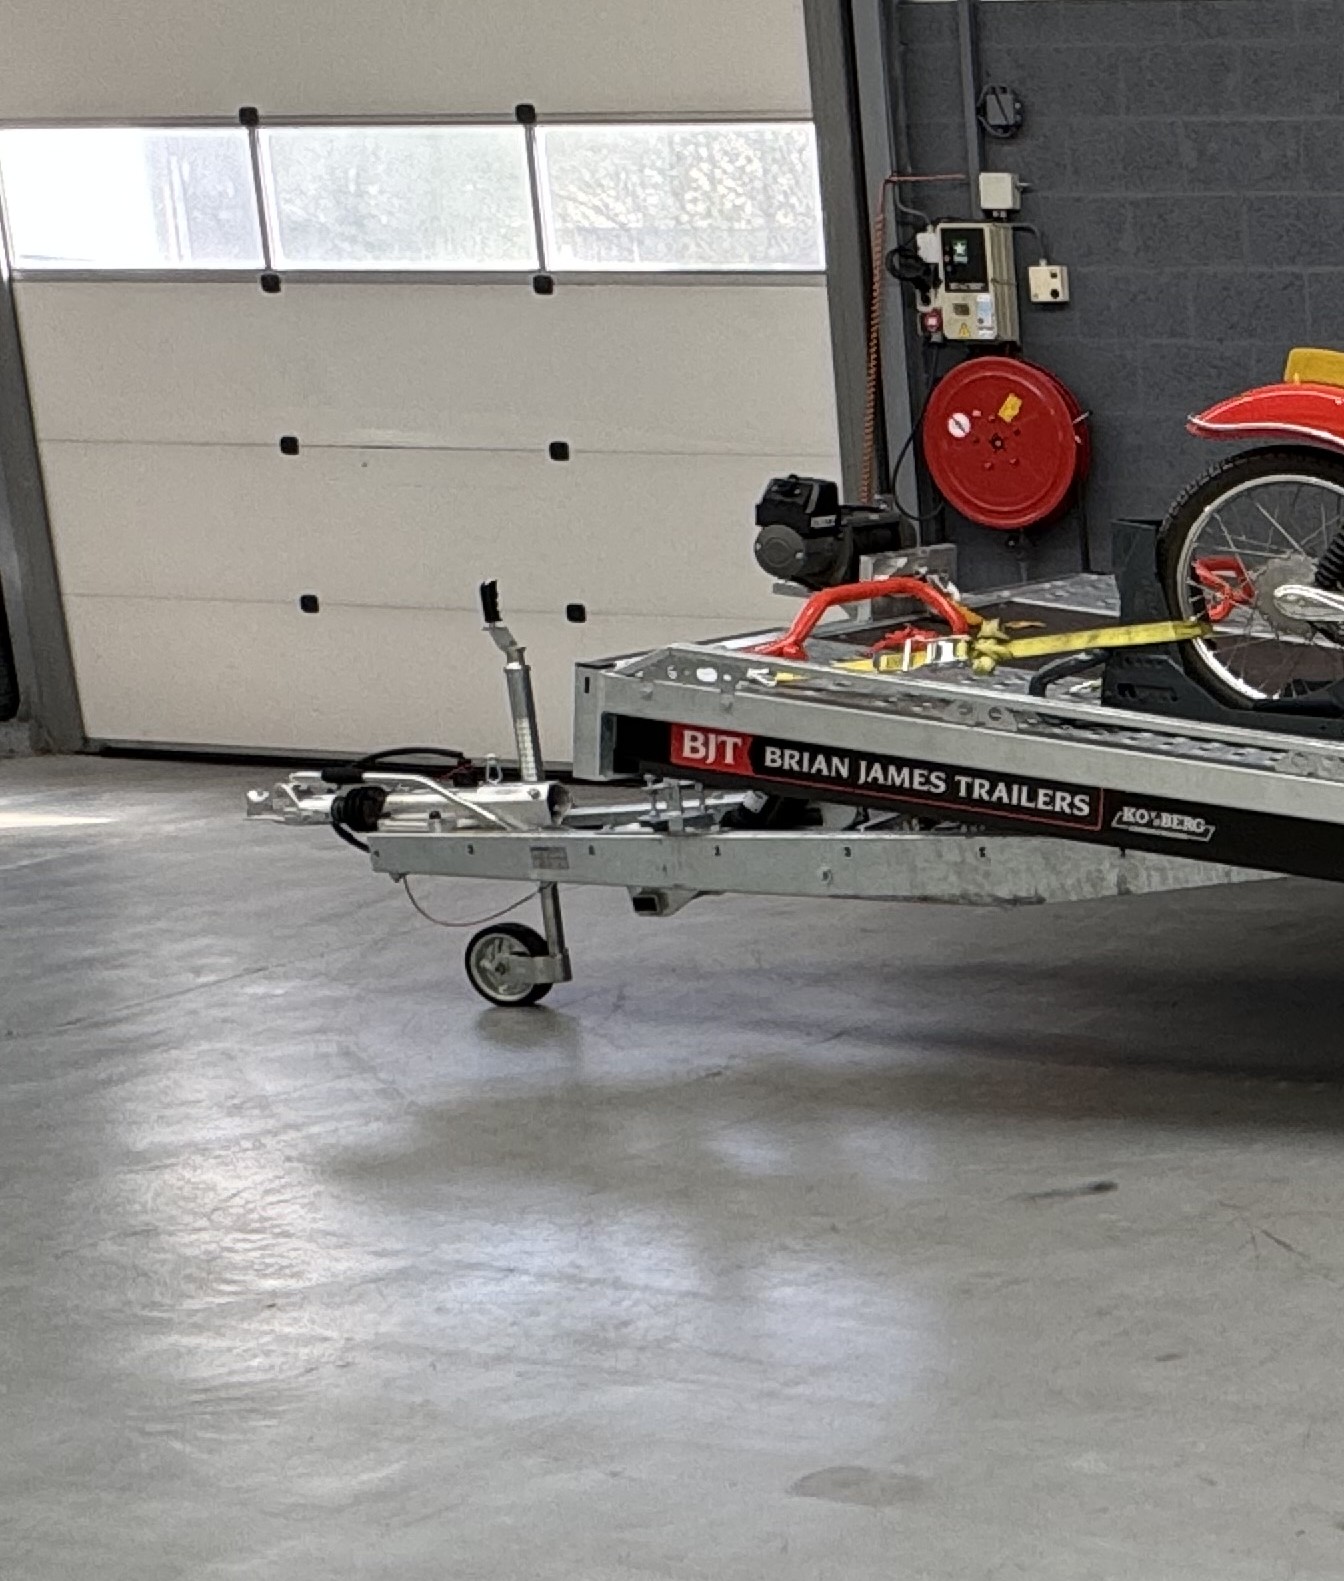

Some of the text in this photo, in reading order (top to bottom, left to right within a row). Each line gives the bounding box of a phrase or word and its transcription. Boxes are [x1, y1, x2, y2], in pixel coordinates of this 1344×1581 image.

[682, 729, 1090, 817] BJT BRIAN JAMES TRAILERS
